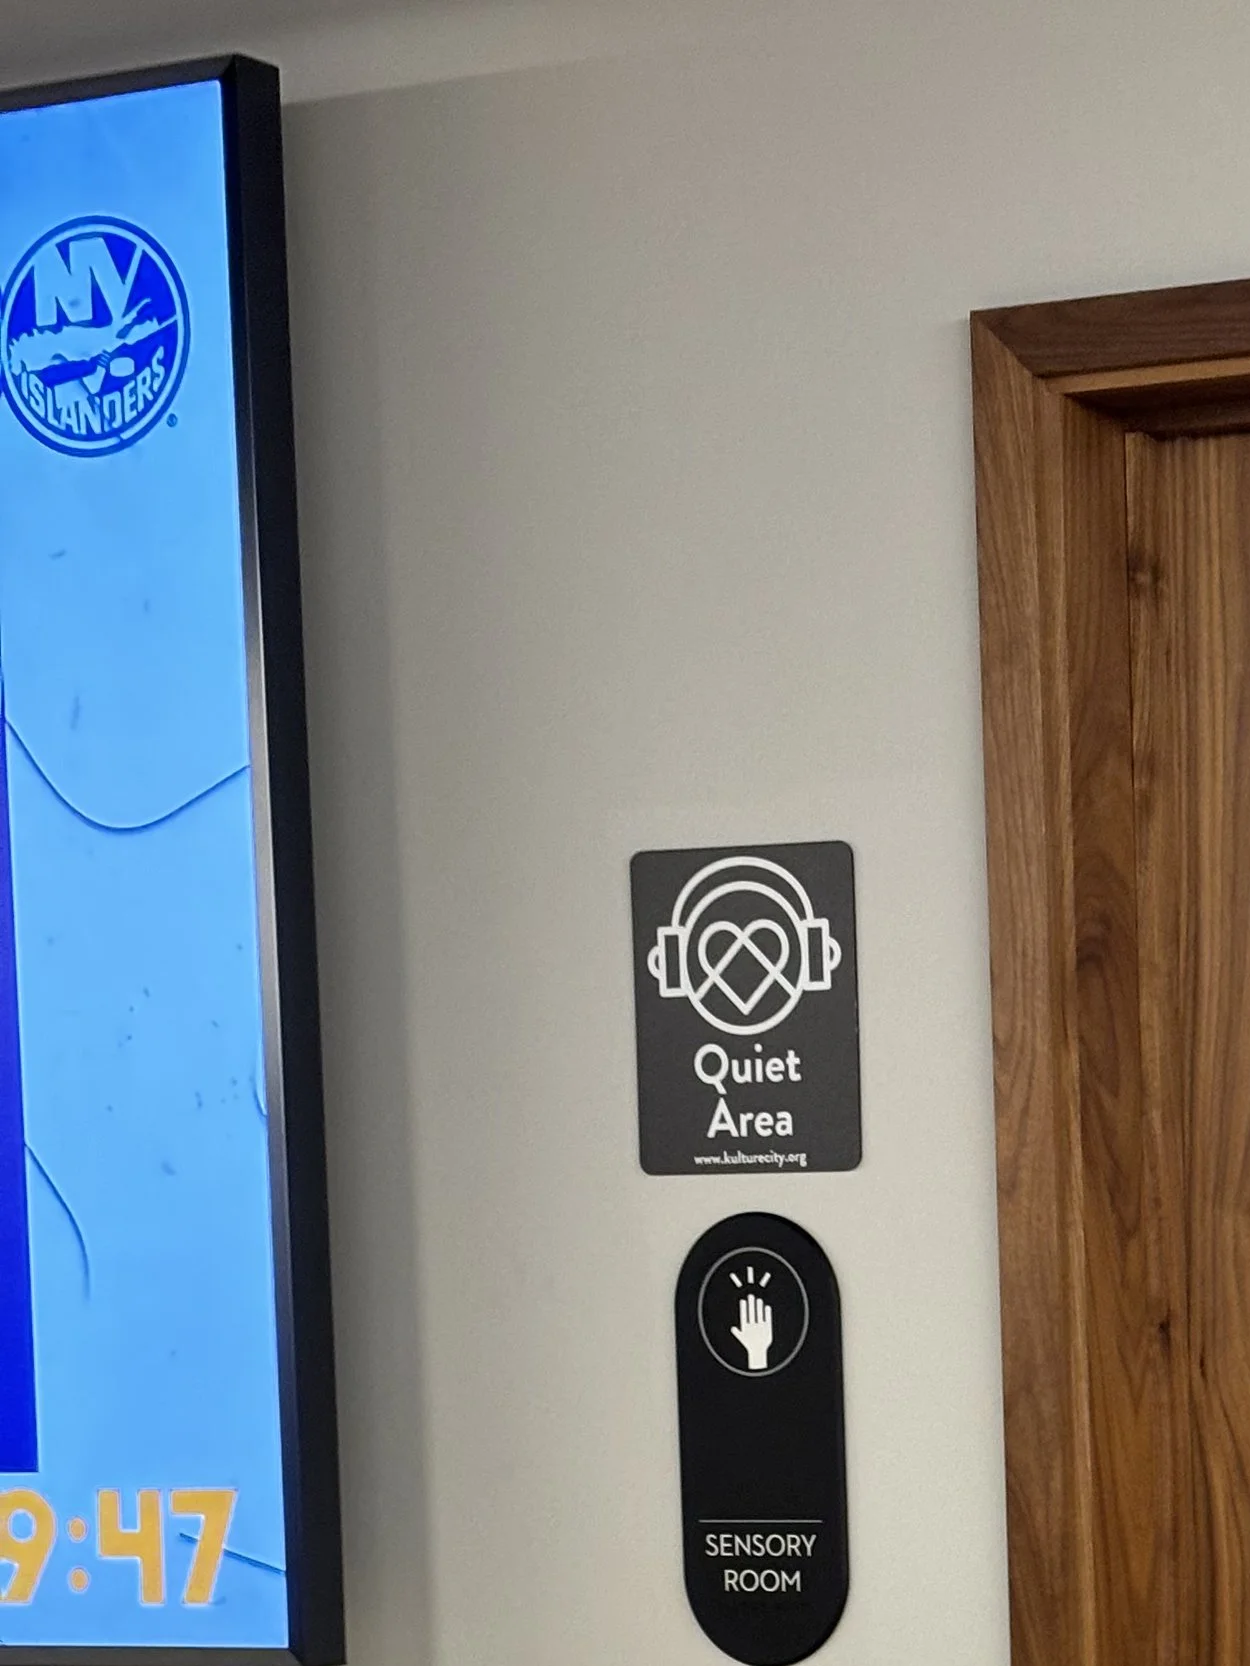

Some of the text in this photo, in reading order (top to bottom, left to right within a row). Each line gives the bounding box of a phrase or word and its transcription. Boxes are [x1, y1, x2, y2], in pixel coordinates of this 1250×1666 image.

[21, 346, 165, 434] ISLANDERS
[694, 1043, 802, 1095] Quiet
[707, 1097, 794, 1138] Area
[694, 1150, 808, 1168] www.kulturecity.org
[0, 1487, 237, 1605] 9:47
[705, 1534, 817, 1557] SENSORY
[724, 1569, 802, 1592] ROOM
